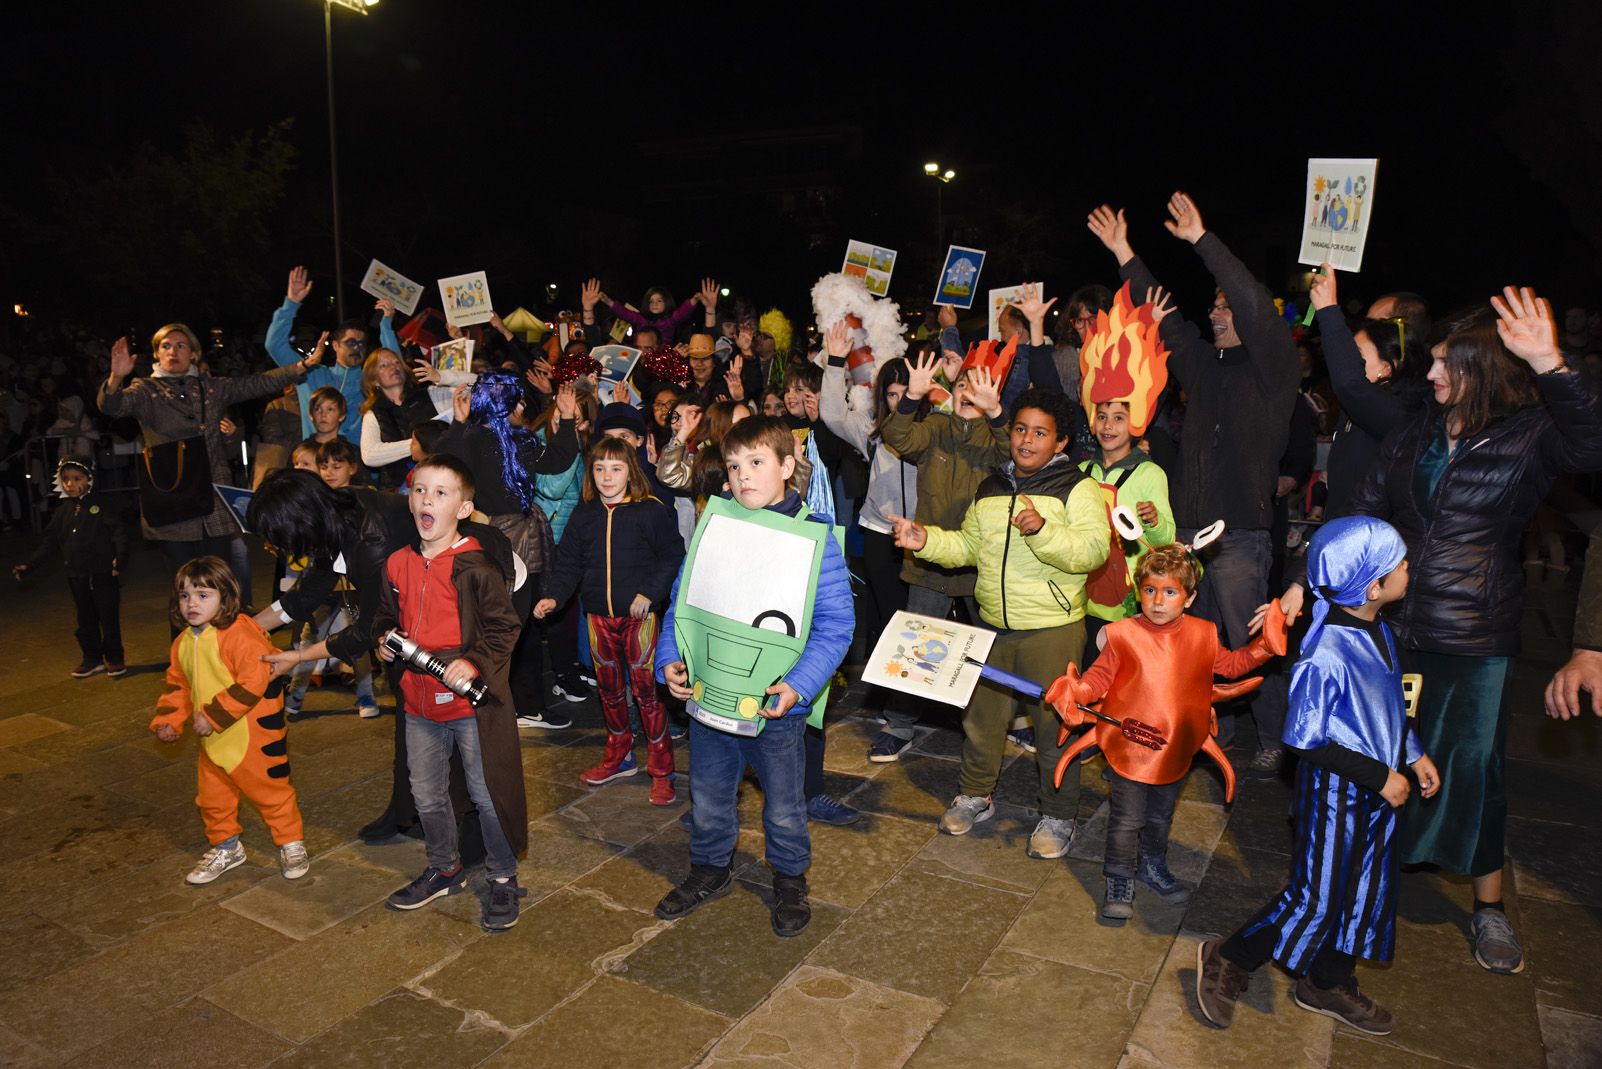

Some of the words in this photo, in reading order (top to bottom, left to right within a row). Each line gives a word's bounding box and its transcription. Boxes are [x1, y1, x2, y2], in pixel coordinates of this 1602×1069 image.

[1341, 244, 1357, 252] FUTURE
[948, 663, 964, 688] MARAGALL
[963, 633, 977, 652] FUTURE
